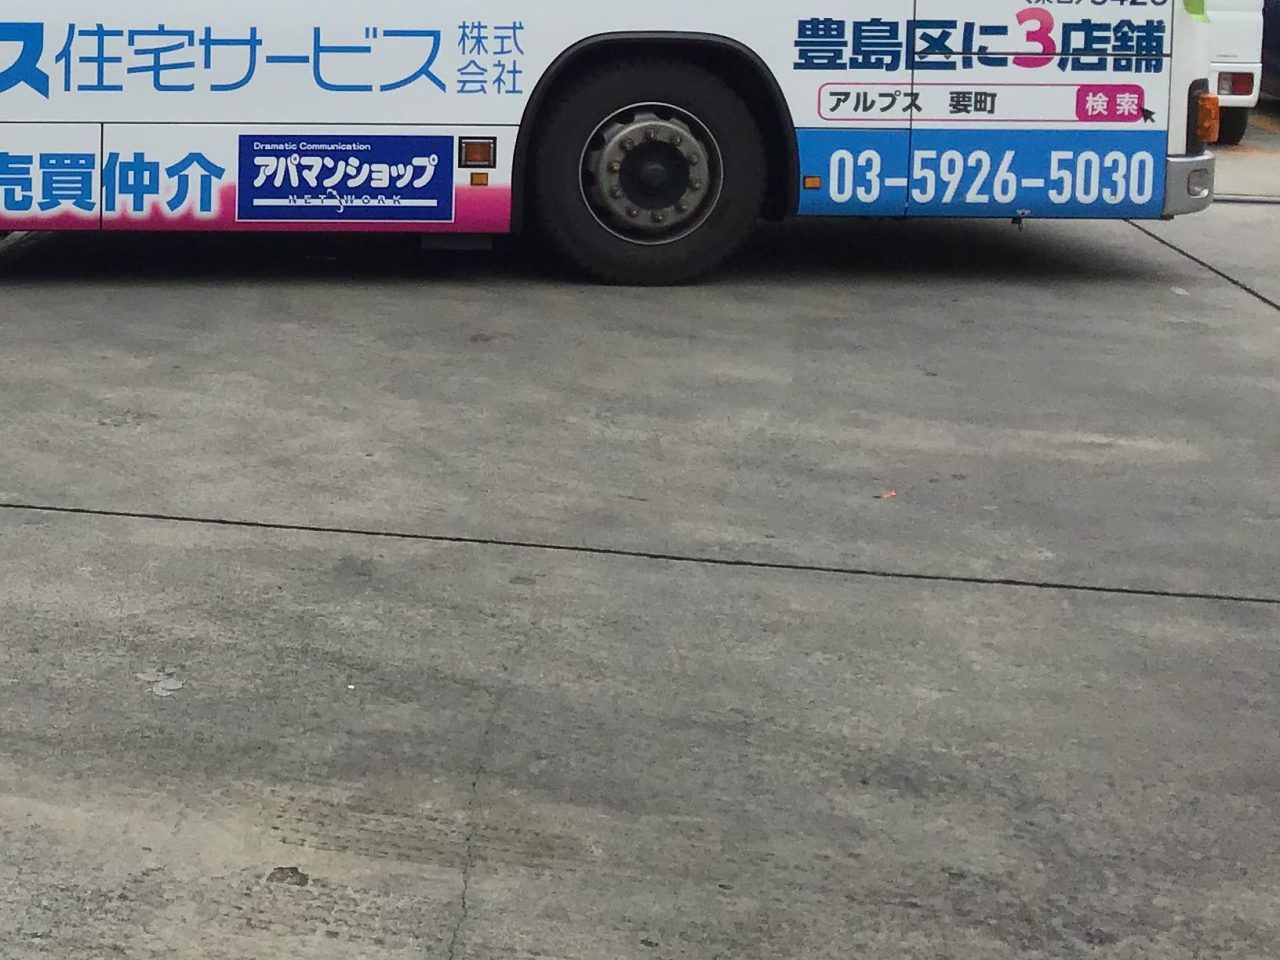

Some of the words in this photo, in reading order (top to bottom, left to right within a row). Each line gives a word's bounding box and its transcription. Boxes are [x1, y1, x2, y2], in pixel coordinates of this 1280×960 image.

[458, 21, 525, 56] 株式
[793, 7, 1166, 73] 豊島区に3店舗
[456, 60, 523, 96] 会社
[829, 90, 923, 113] アルプス
[948, 90, 998, 115] 要町
[1085, 92, 1139, 116] 検索
[253, 142, 297, 150] Dramatic
[299, 142, 371, 151] Communication
[253, 153, 439, 189] アパマンショップ
[828, 149, 1155, 205] 03-5926-5030
